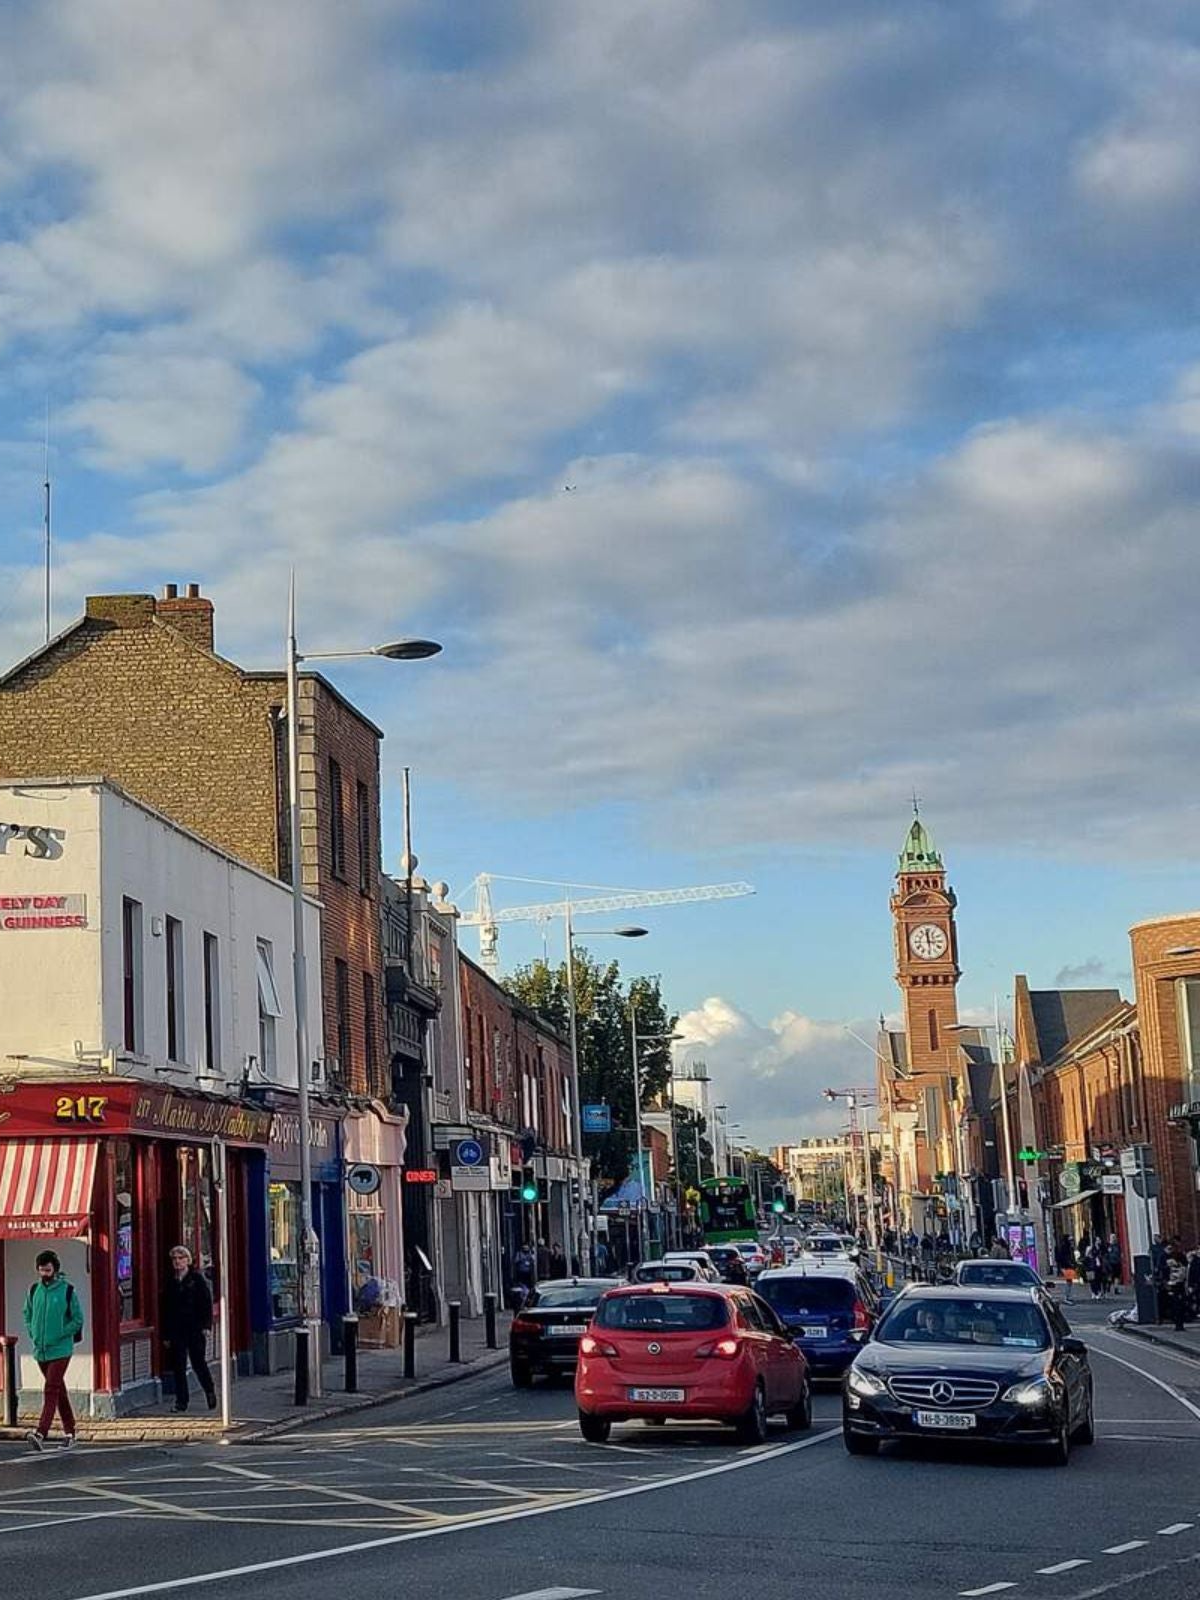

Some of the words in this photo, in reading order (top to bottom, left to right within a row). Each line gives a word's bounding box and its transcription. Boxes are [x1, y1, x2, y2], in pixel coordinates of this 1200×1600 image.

[33, 897, 67, 909] DAY
[56, 1096, 108, 1121] 217
[153, 1093, 197, 1129] Martin
